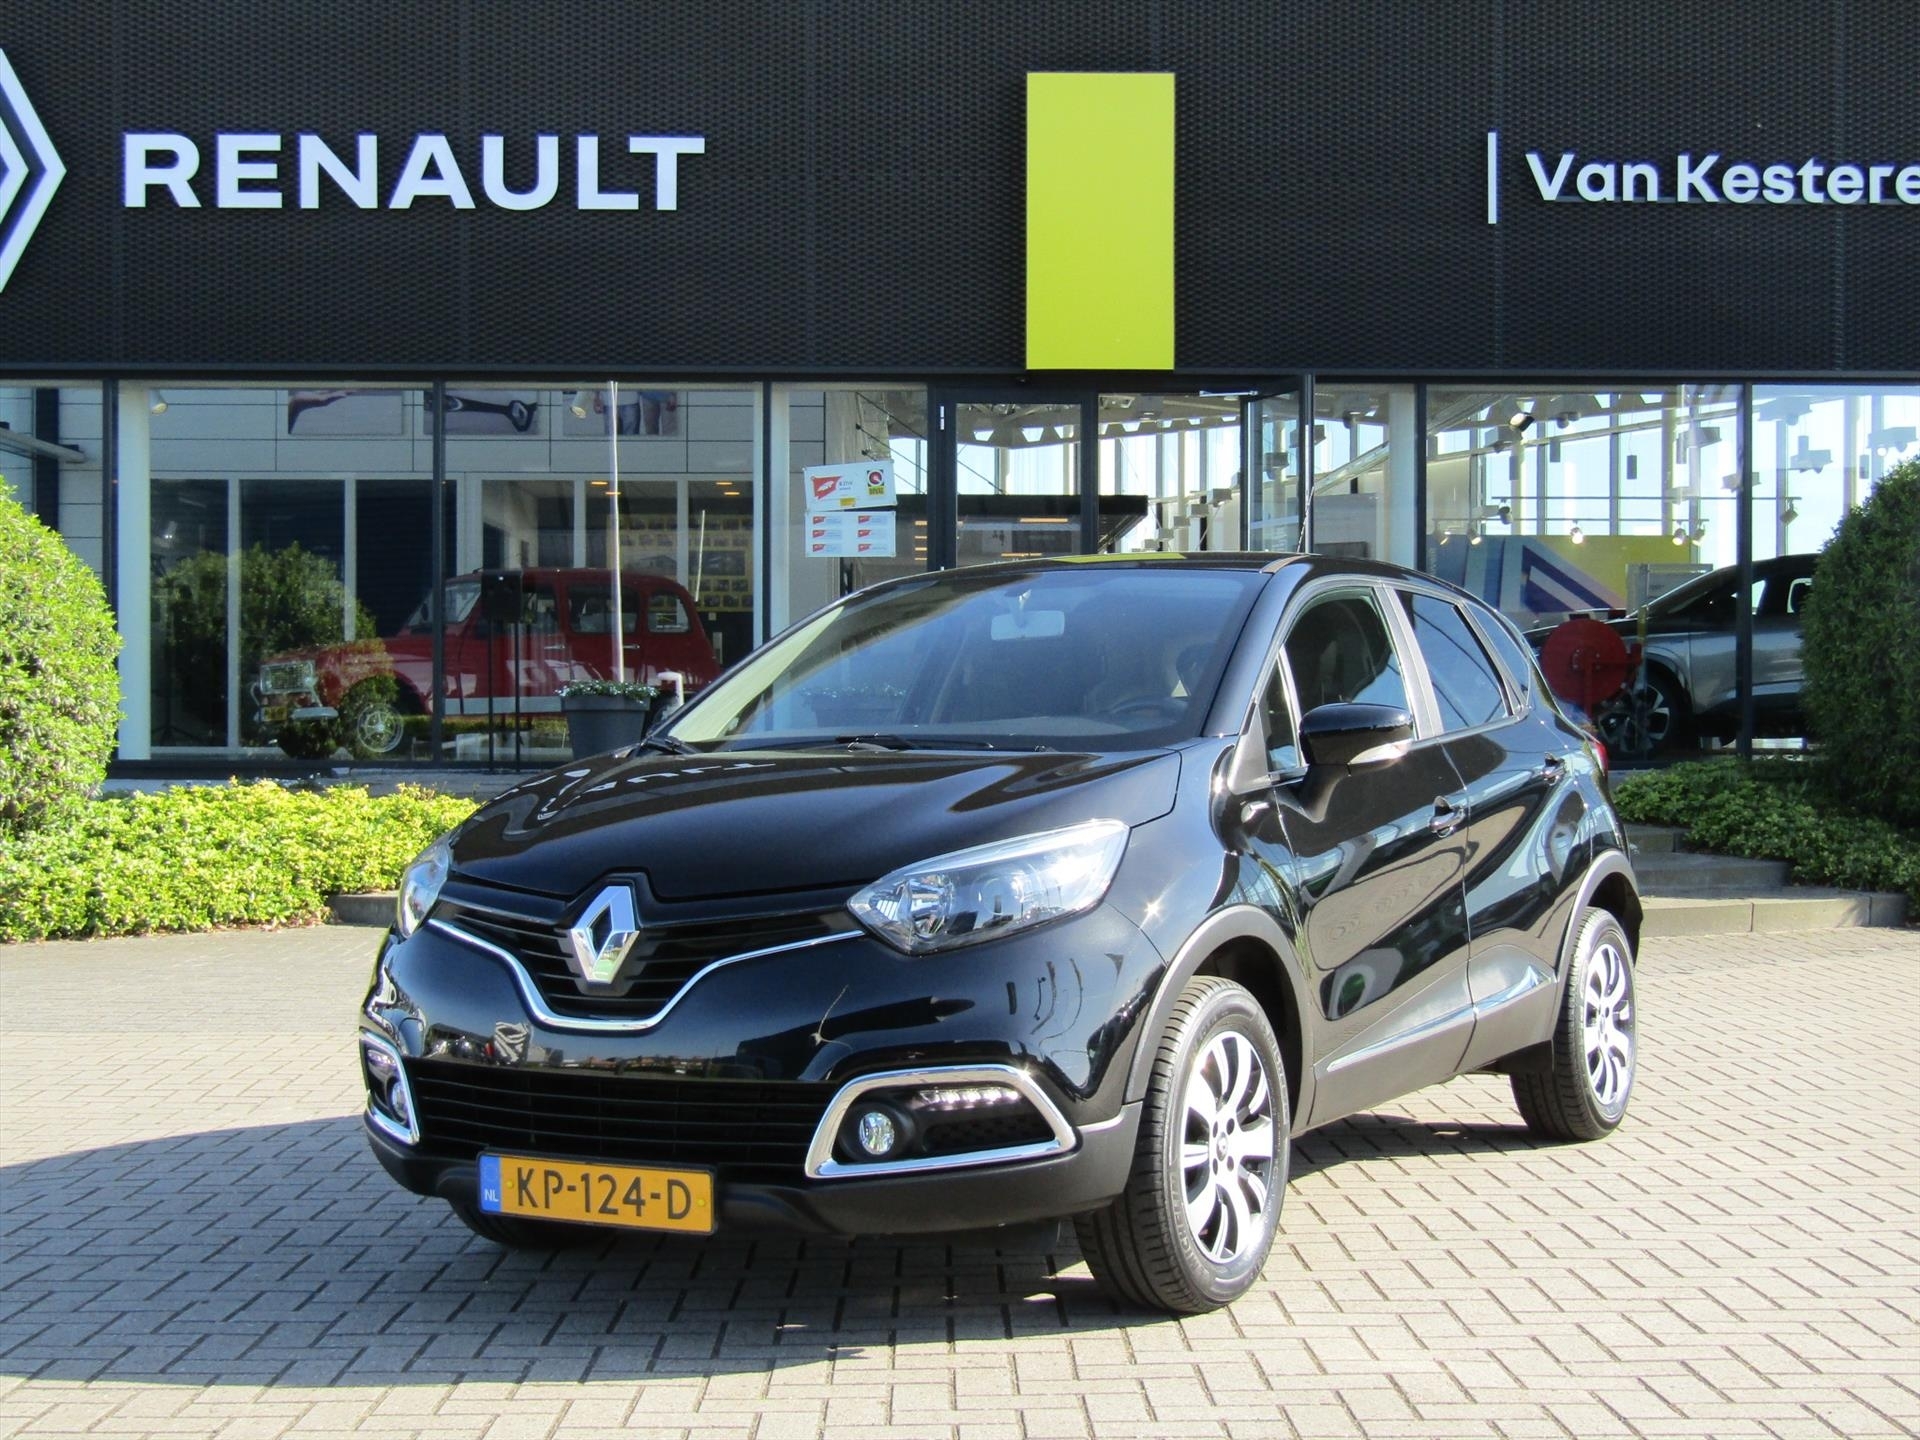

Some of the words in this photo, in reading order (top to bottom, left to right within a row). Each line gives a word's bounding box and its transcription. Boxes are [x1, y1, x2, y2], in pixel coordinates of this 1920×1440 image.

[123, 133, 706, 211] RENAULT
[1525, 153, 1659, 203] Van
[1676, 154, 1920, 204] Kestere
[484, 1188, 499, 1203] NL
[517, 1166, 692, 1220] KP-124-D
